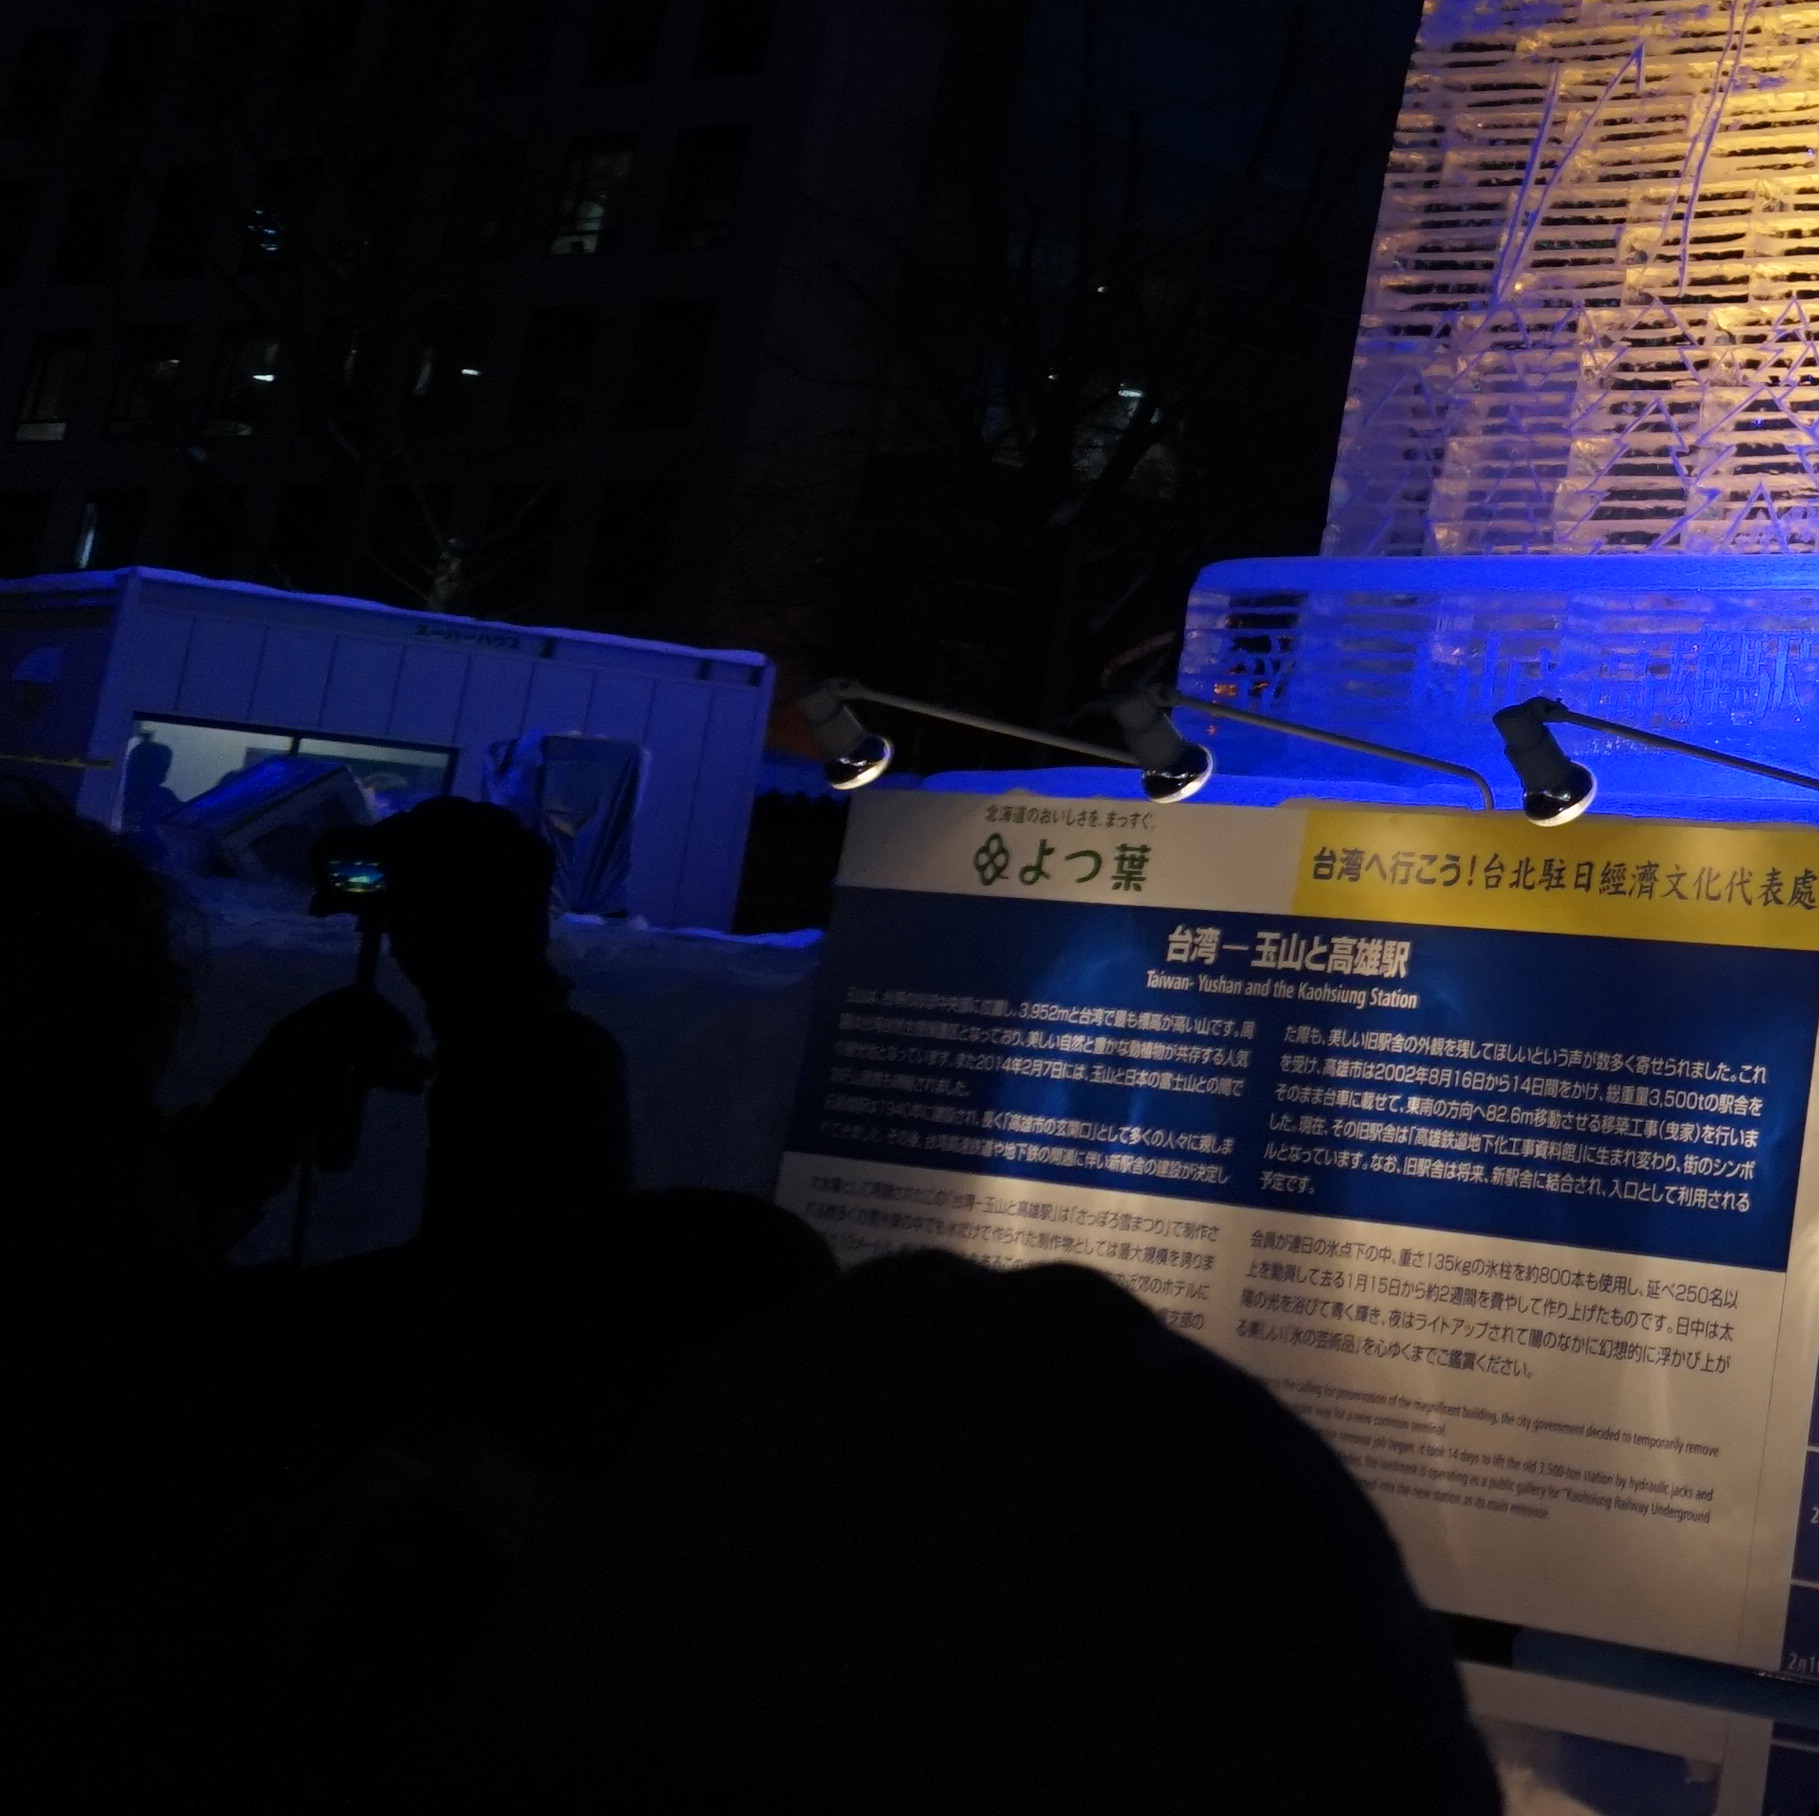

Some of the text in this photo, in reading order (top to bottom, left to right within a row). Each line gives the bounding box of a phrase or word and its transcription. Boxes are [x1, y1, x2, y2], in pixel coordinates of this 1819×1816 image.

[1018, 838, 1151, 892] よつ葉
[1198, 974, 1243, 997] Yushan
[1244, 977, 1270, 997] and
[1273, 979, 1295, 1000] the
[1298, 981, 1367, 1009] Kaohsiung
[1370, 987, 1418, 1010] Station
[1258, 1171, 1318, 1196] 予定です。
[1532, 1416, 1586, 1440] government
[1585, 1422, 1620, 1442] decided
[1632, 1430, 1684, 1455] temporarily
[1684, 1439, 1720, 1458] remove
[1694, 1485, 1714, 1502] and
[1649, 1500, 1711, 1527] Underground
